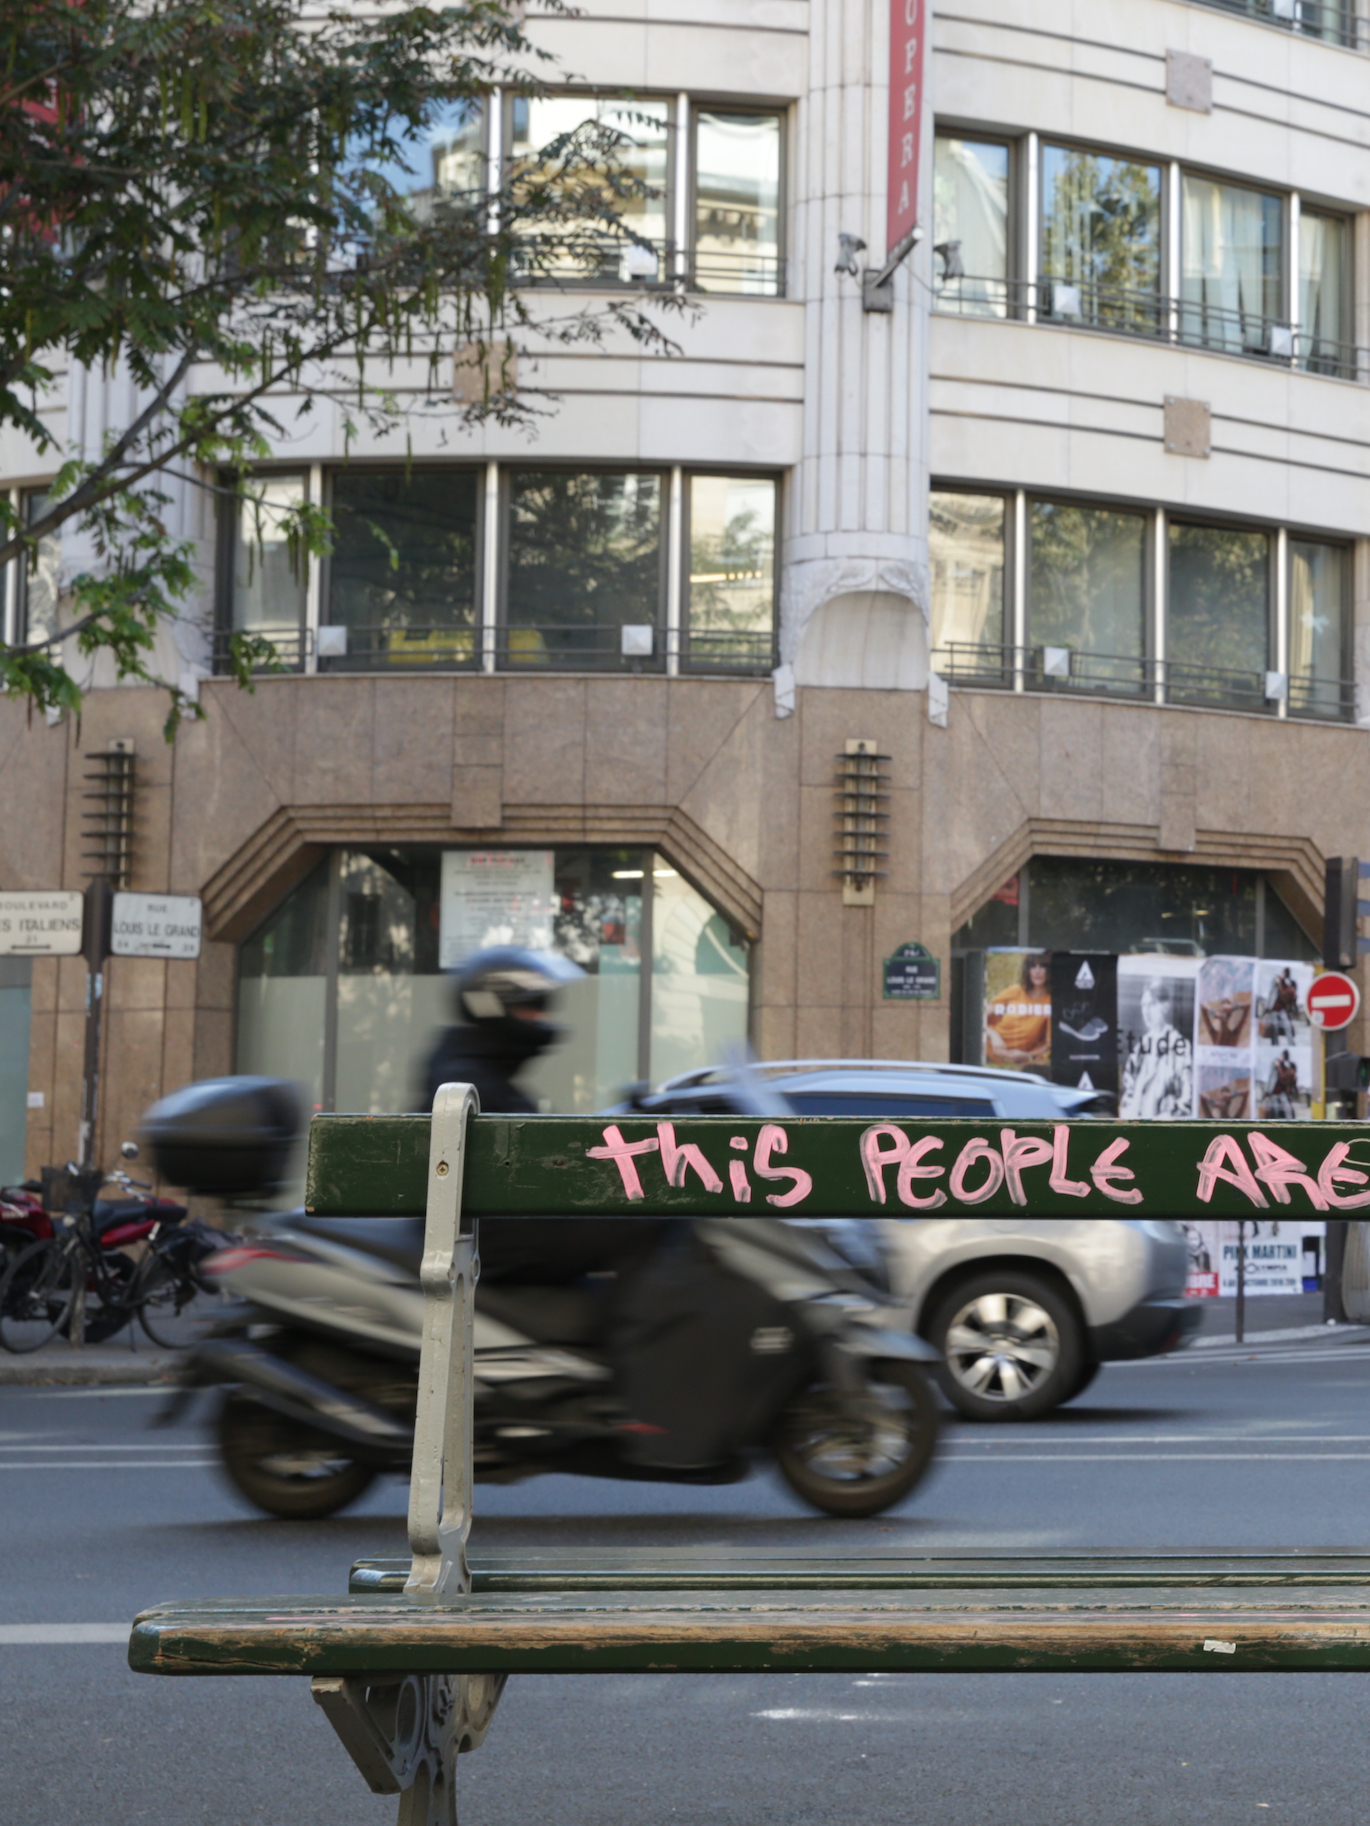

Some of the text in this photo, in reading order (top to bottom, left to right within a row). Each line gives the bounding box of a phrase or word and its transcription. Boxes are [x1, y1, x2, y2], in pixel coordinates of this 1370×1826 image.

[897, 0, 918, 215] OPERA
[0, 901, 68, 910] OULEVARD
[19, 918, 81, 932] ITALIENS
[113, 920, 201, 937] LOUIS LE GRAND
[859, 1123, 1144, 1209] PEOPLE
[1252, 1245, 1298, 1259] MARTINI
